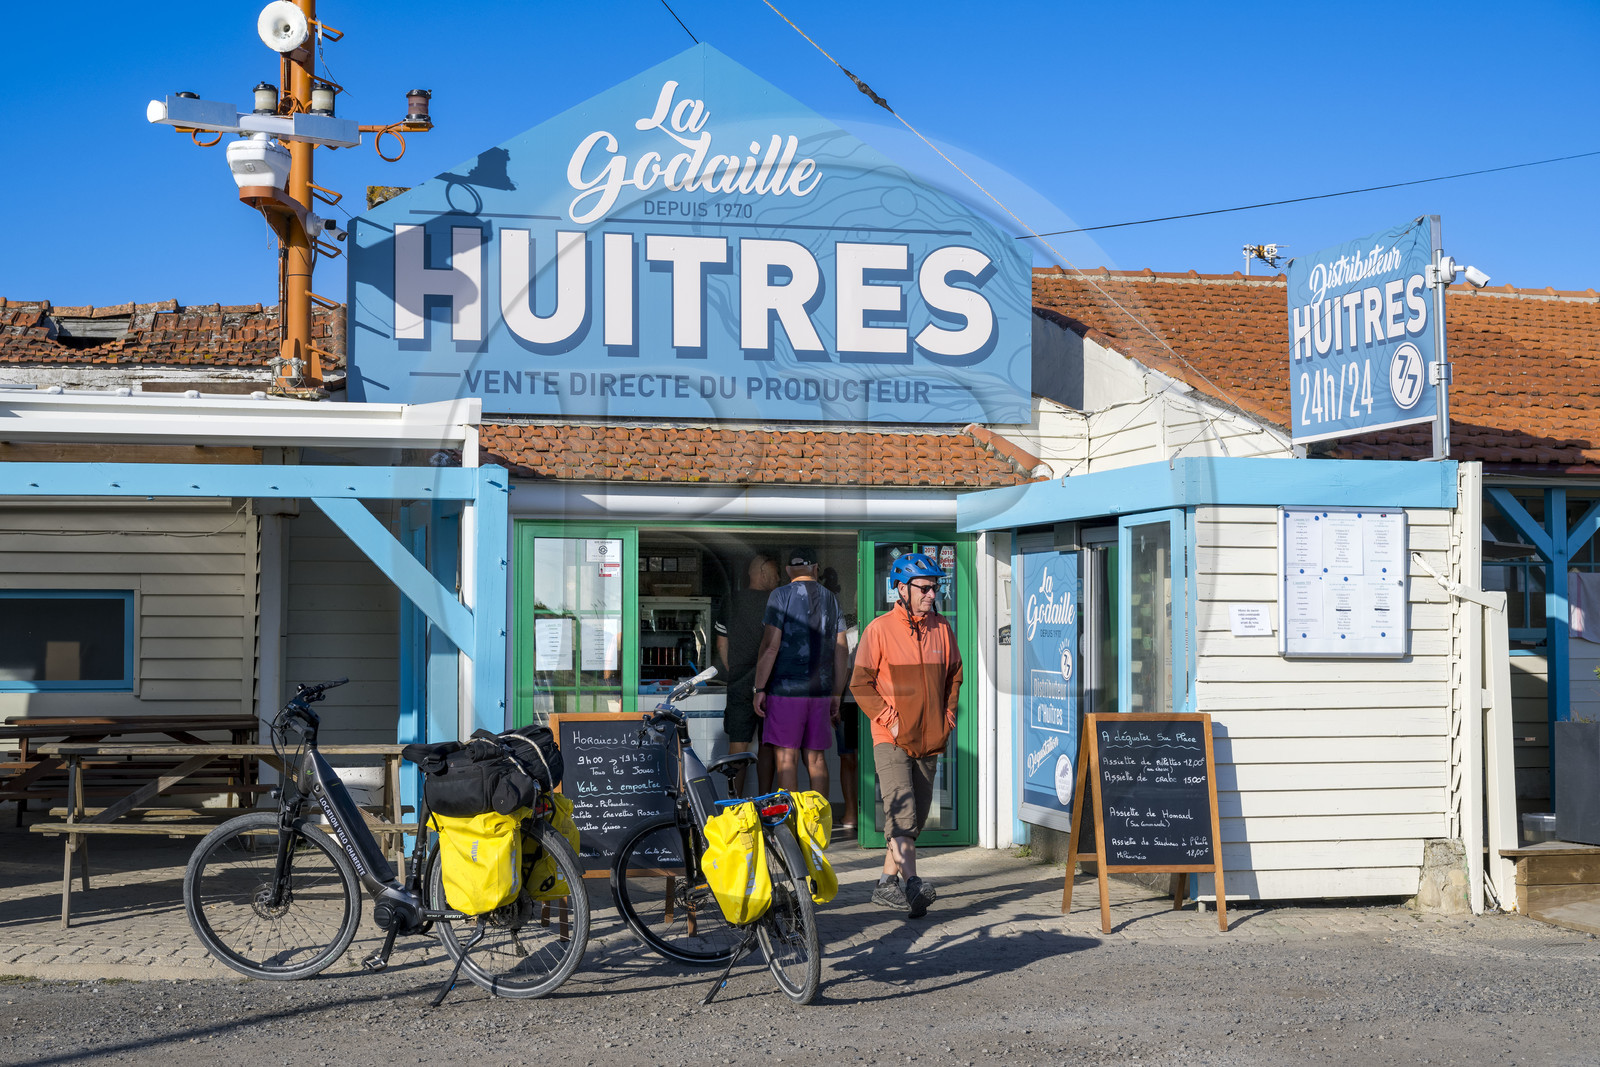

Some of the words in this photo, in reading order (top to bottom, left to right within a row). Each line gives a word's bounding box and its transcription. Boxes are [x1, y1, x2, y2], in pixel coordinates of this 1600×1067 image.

[635, 80, 711, 138] La
[566, 130, 824, 225] Godaille
[643, 200, 708, 217] DEPUIS
[713, 203, 753, 219] 1970
[1309, 244, 1402, 309] Distributeur
[393, 225, 997, 364] HUITRES
[1293, 275, 1428, 362] HUITRES
[464, 369, 560, 396] VENTE
[569, 372, 689, 398] DIRECTE
[700, 375, 736, 400] DU
[746, 376, 930, 403] PRODUCTEUR
[1300, 359, 1374, 426] 24h/24
[1397, 354, 1418, 399] 7/7
[1039, 566, 1054, 593] La
[1027, 592, 1075, 641] Godaille
[1102, 731, 1110, 743] A
[1114, 730, 1152, 745] déguster
[1176, 732, 1197, 743] Place
[577, 755, 604, 765] 9h00
[1103, 756, 1137, 766] Assiette
[1141, 756, 1152, 766] de
[1137, 772, 1148, 782] de
[577, 781, 599, 793] Vente
[607, 779, 614, 791] à
[620, 779, 661, 793] emporter
[1145, 808, 1156, 818] de
[319, 797, 339, 828] LOCATION
[336, 826, 348, 845] VELO
[345, 844, 366, 876] CHARENTE
[470, 840, 479, 863] THULE
